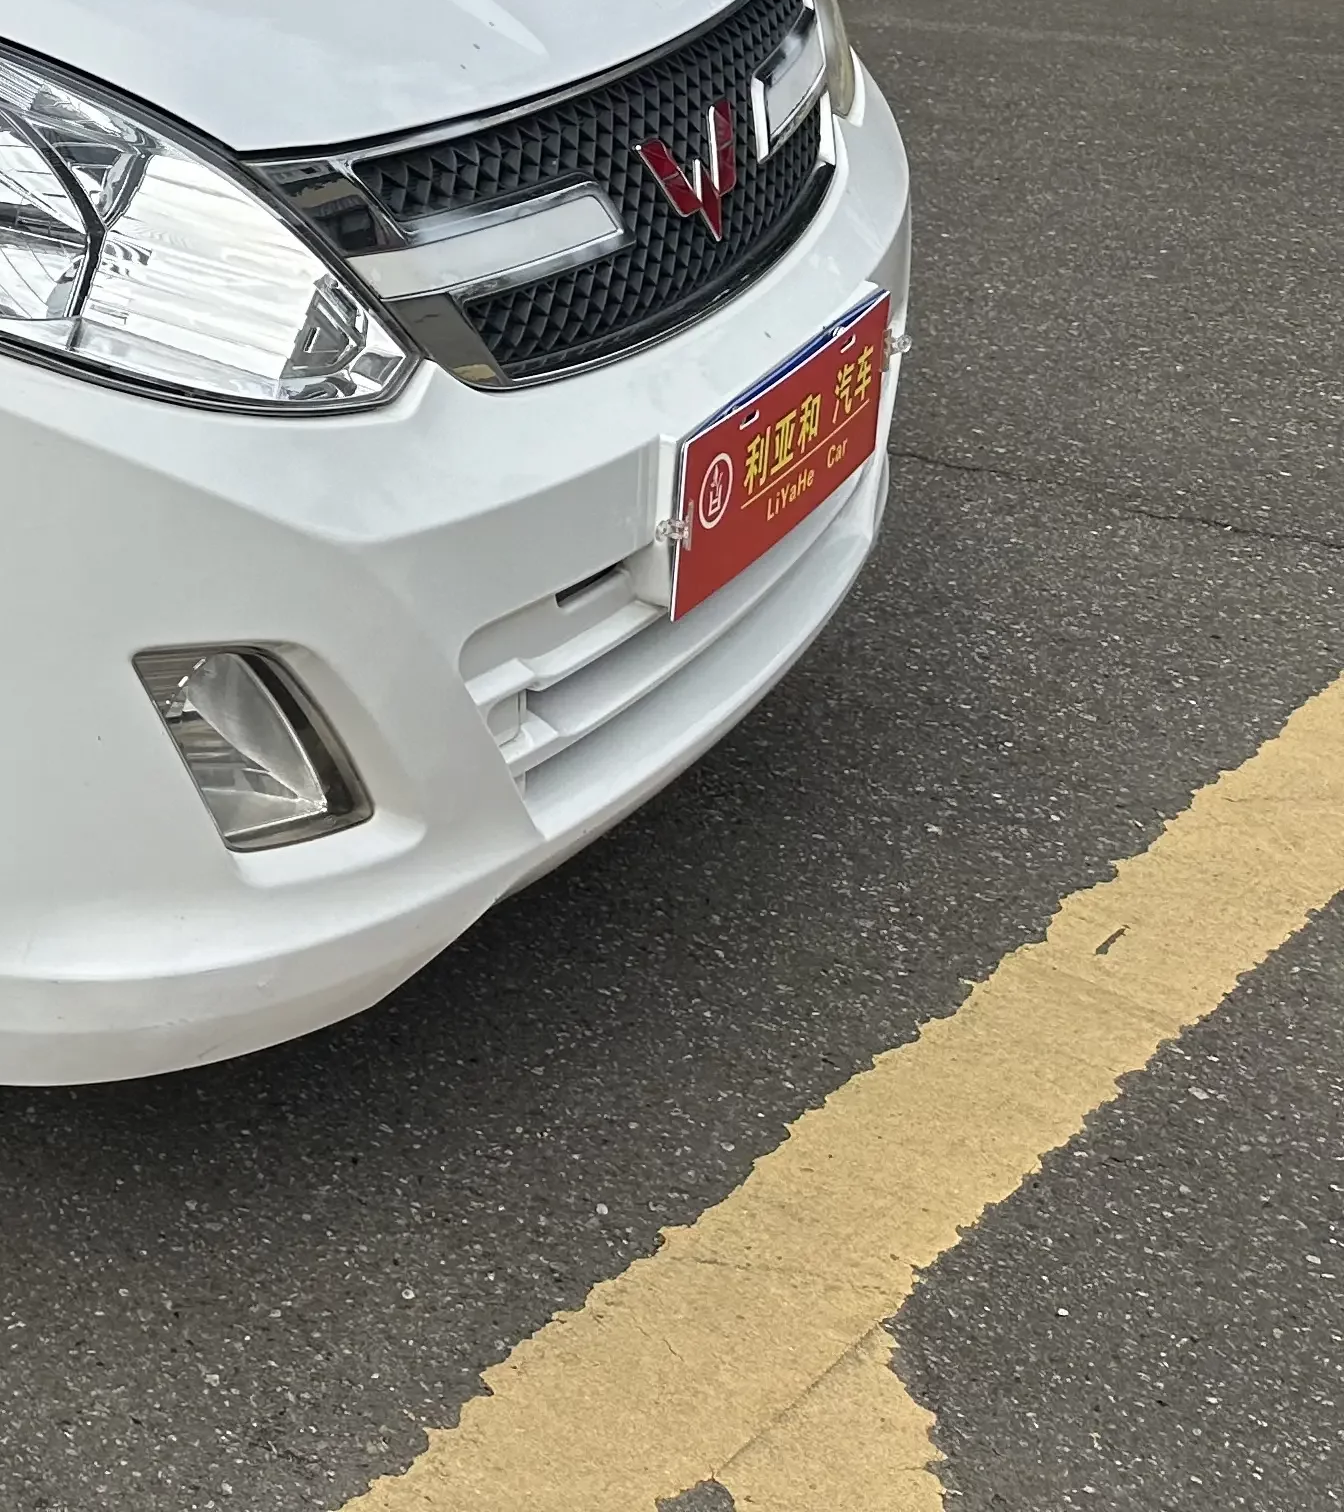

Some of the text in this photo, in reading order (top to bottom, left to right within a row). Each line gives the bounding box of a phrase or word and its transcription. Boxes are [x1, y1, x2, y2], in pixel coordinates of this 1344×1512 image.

[743, 344, 876, 494] 利亚和 汽车
[766, 437, 849, 521] LiYaHe Car
